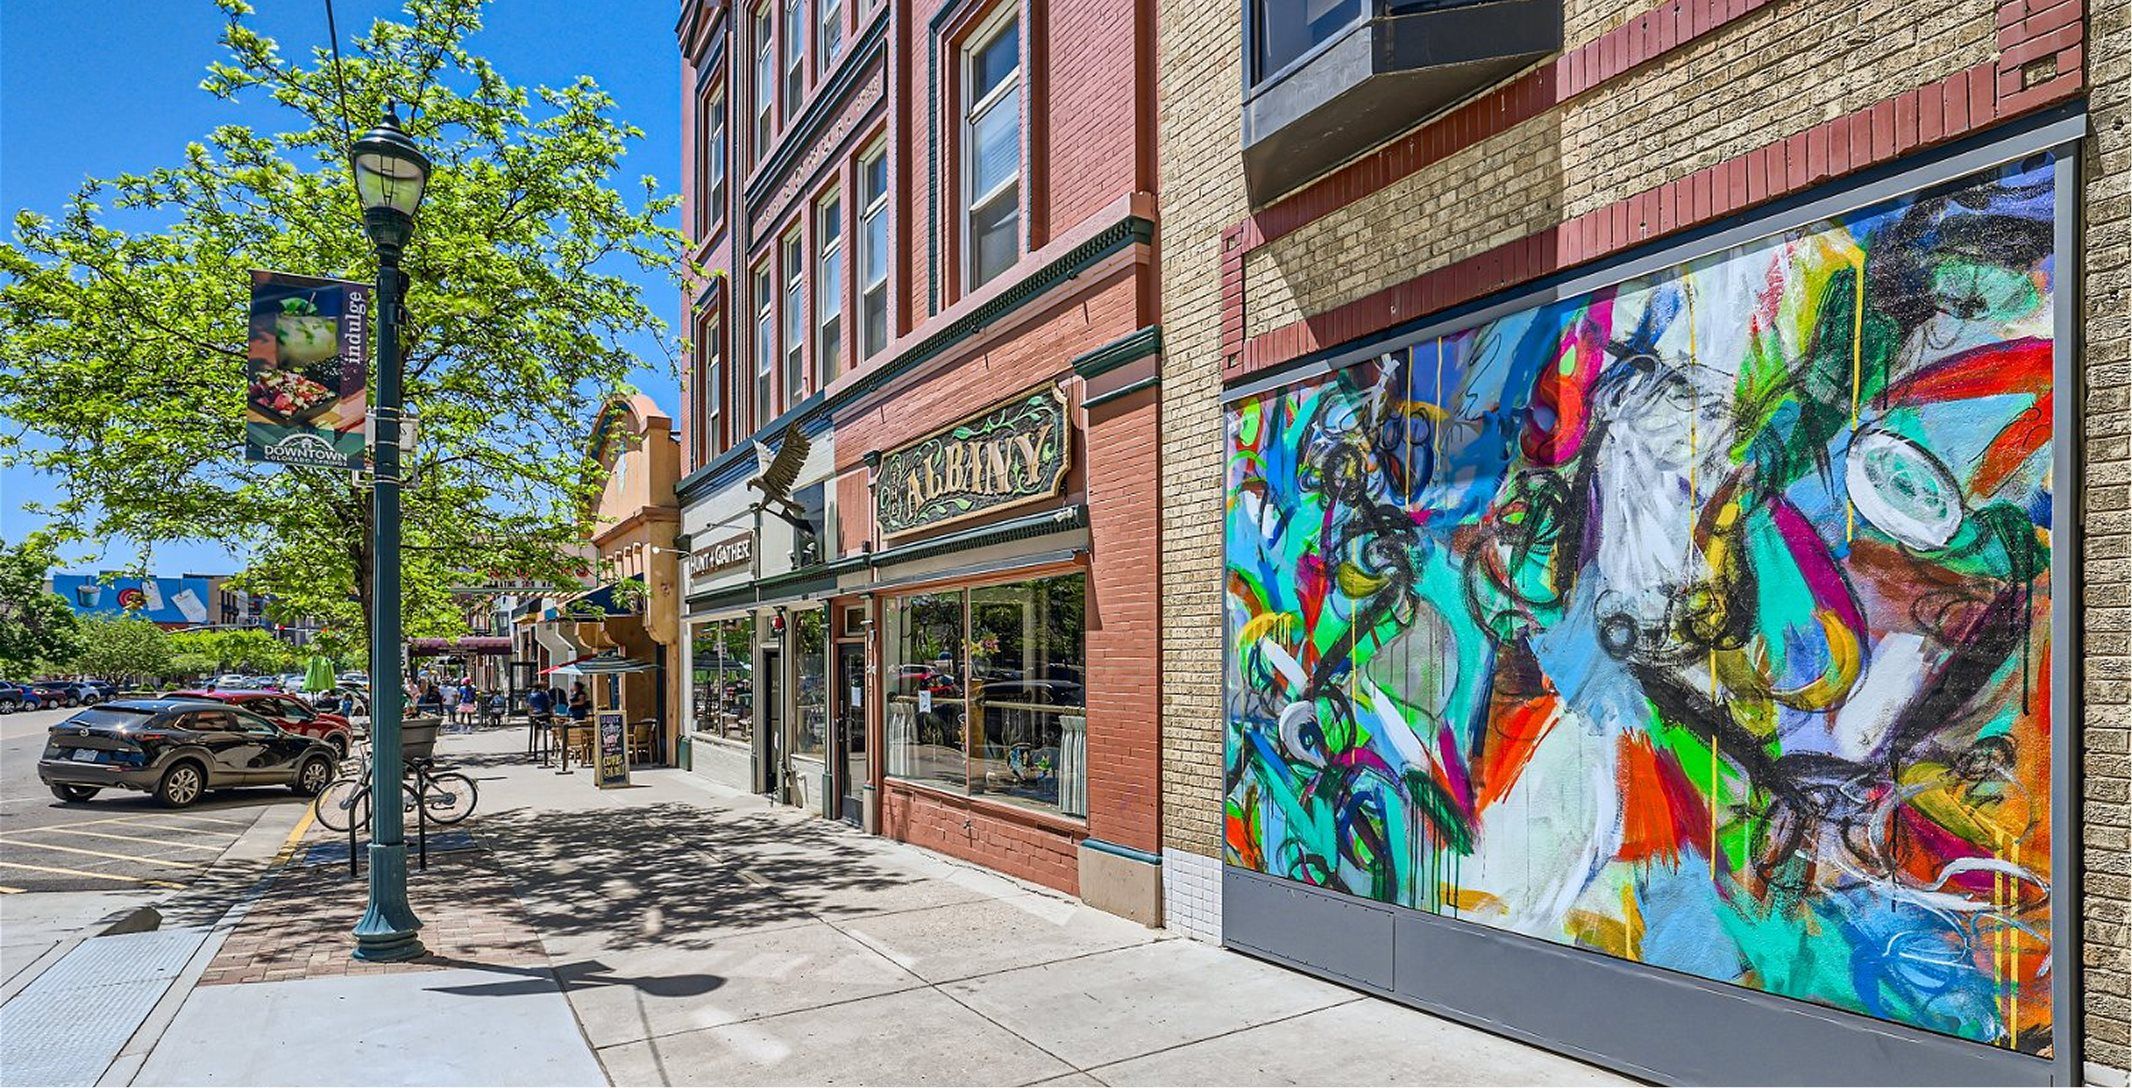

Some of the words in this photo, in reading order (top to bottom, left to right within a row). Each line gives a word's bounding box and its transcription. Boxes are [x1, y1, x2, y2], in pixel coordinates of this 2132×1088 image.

[345, 291, 367, 364] indulge
[264, 445, 348, 462] DOWNTOWN
[264, 455, 311, 464] COLORADO
[906, 423, 1054, 520] ALBANY
[690, 552, 710, 575] HUNT
[715, 540, 751, 566] GATHER
